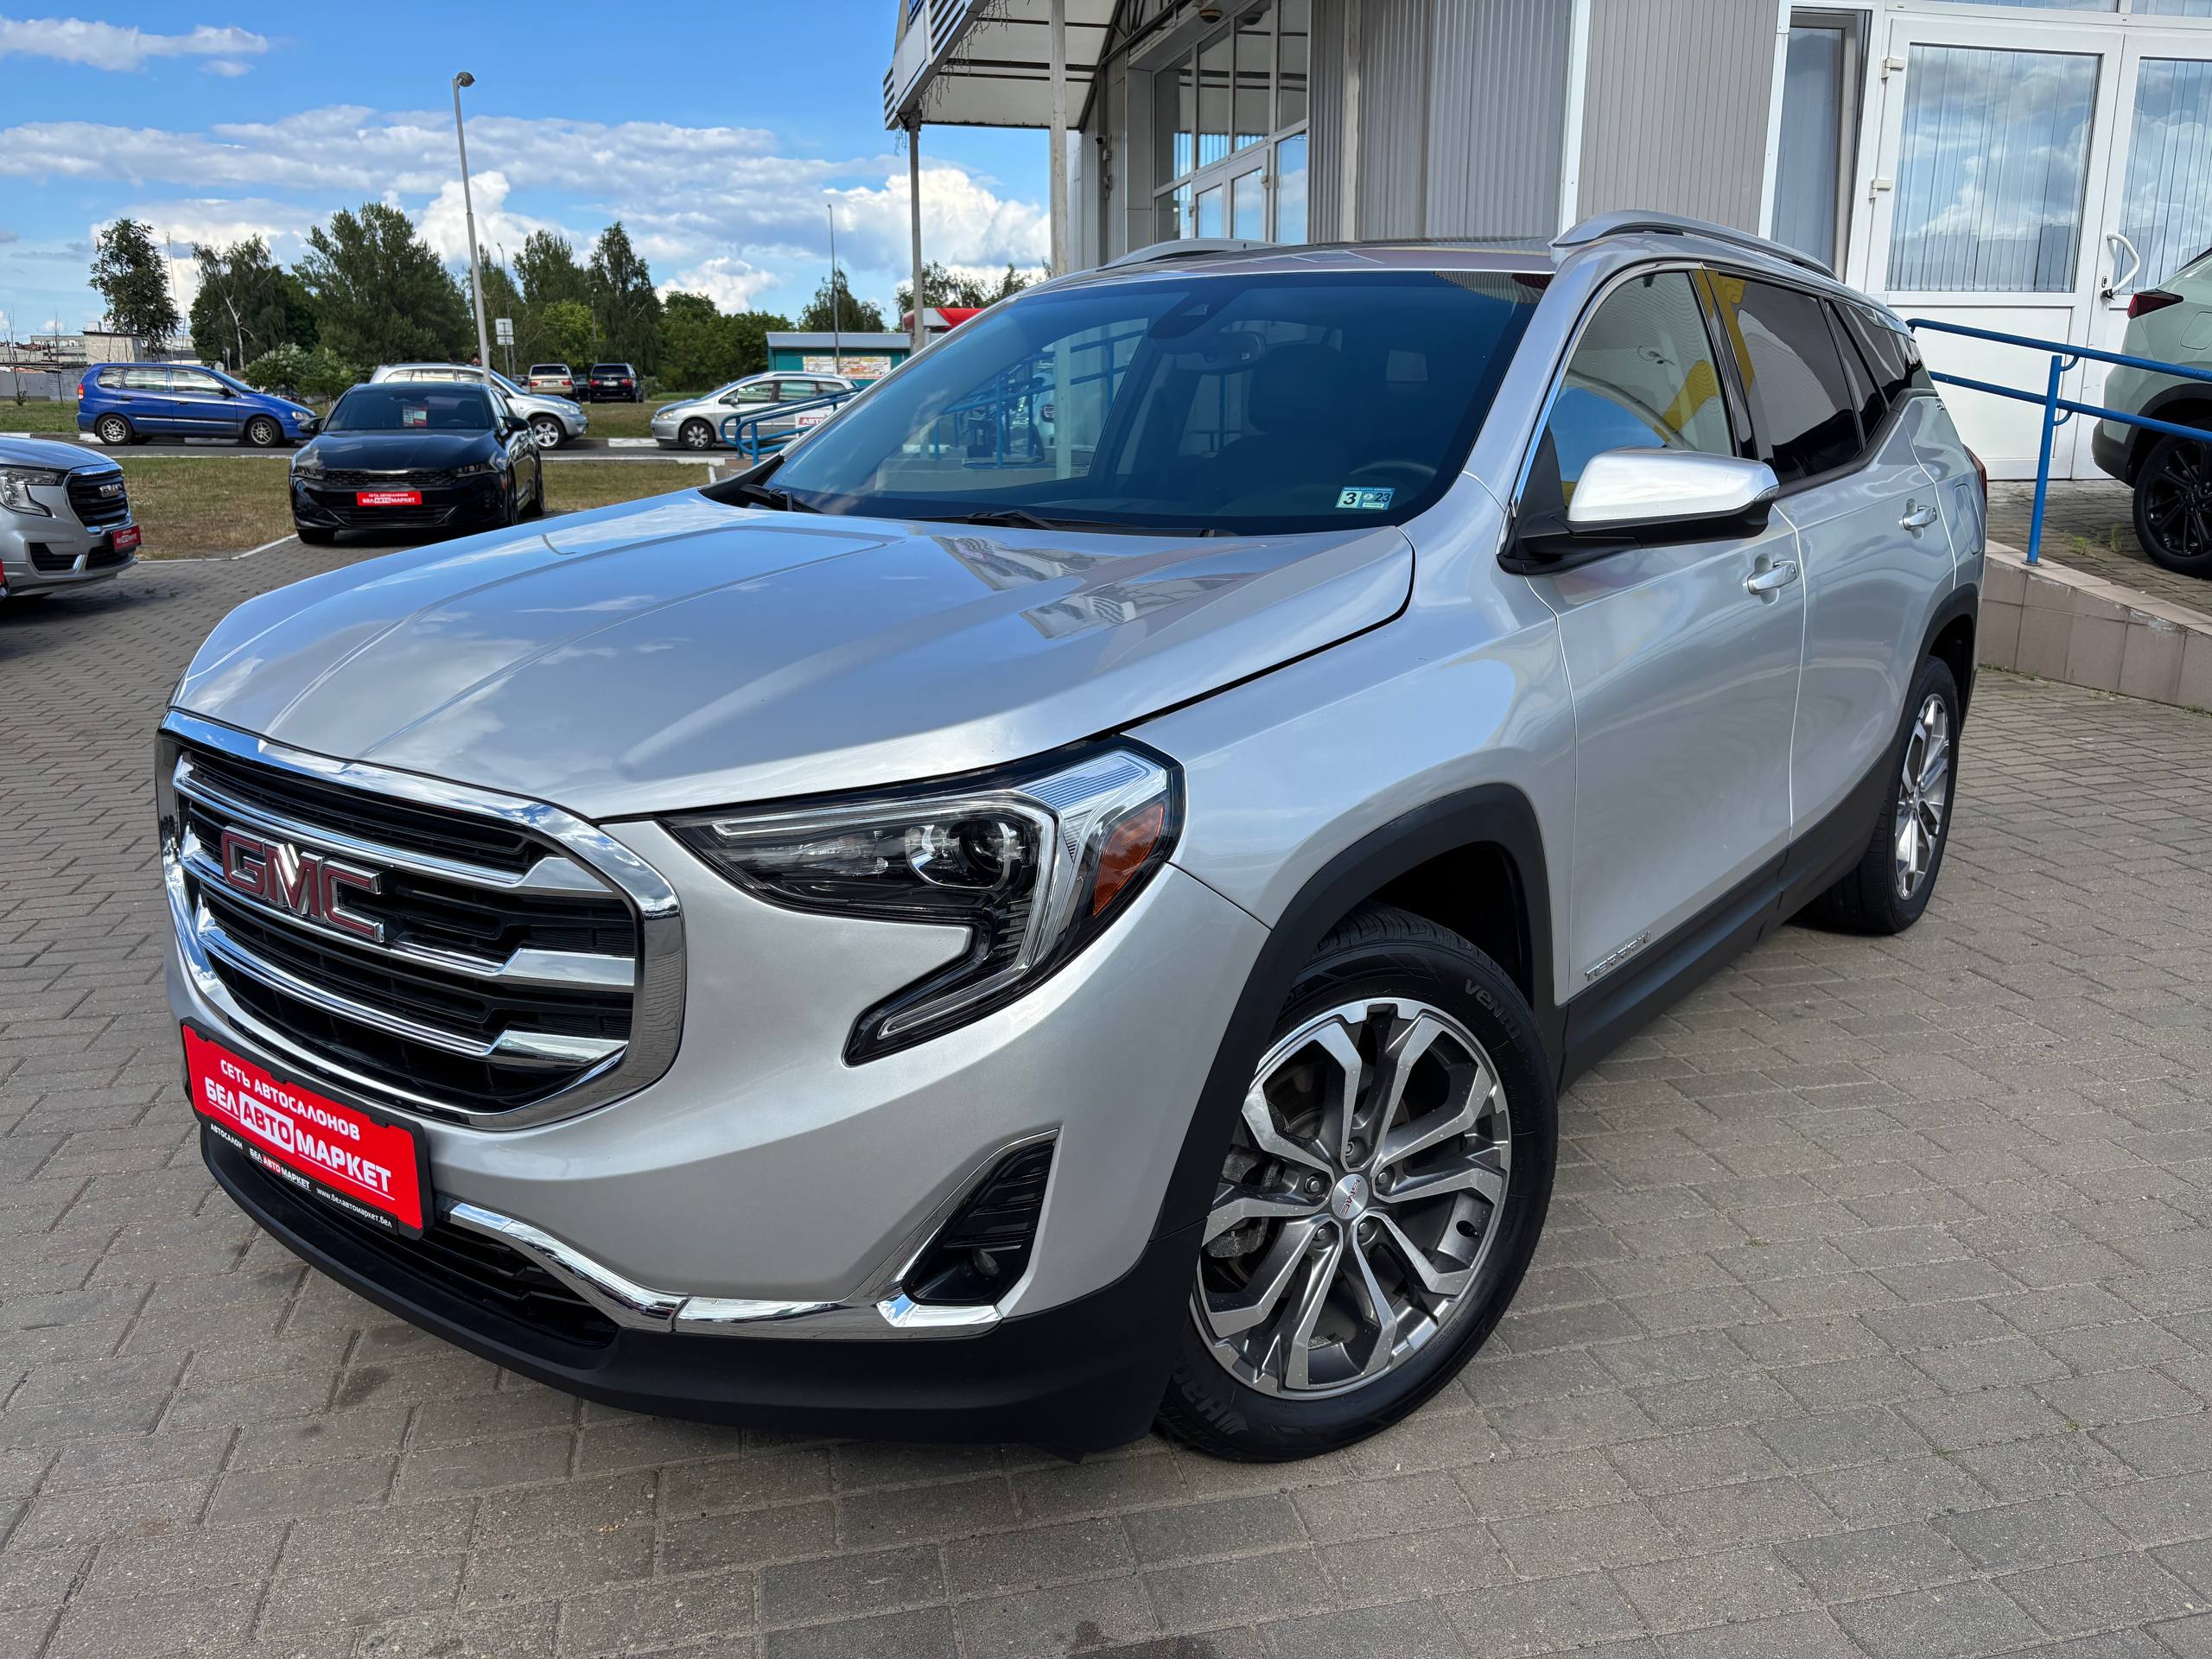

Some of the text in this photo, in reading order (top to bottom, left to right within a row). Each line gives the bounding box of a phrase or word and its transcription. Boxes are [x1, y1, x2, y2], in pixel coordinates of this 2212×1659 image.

[1343, 493, 1357, 505] 3
[1374, 493, 1391, 503] 23
[220, 823, 385, 944] GMC
[220, 1058, 360, 1141] СЕТЬ АВТОСАЛОНОВ
[210, 1122, 244, 1150] АВТОСАЛОН
[316, 1187, 392, 1228] www.белавтомаркет.бел
